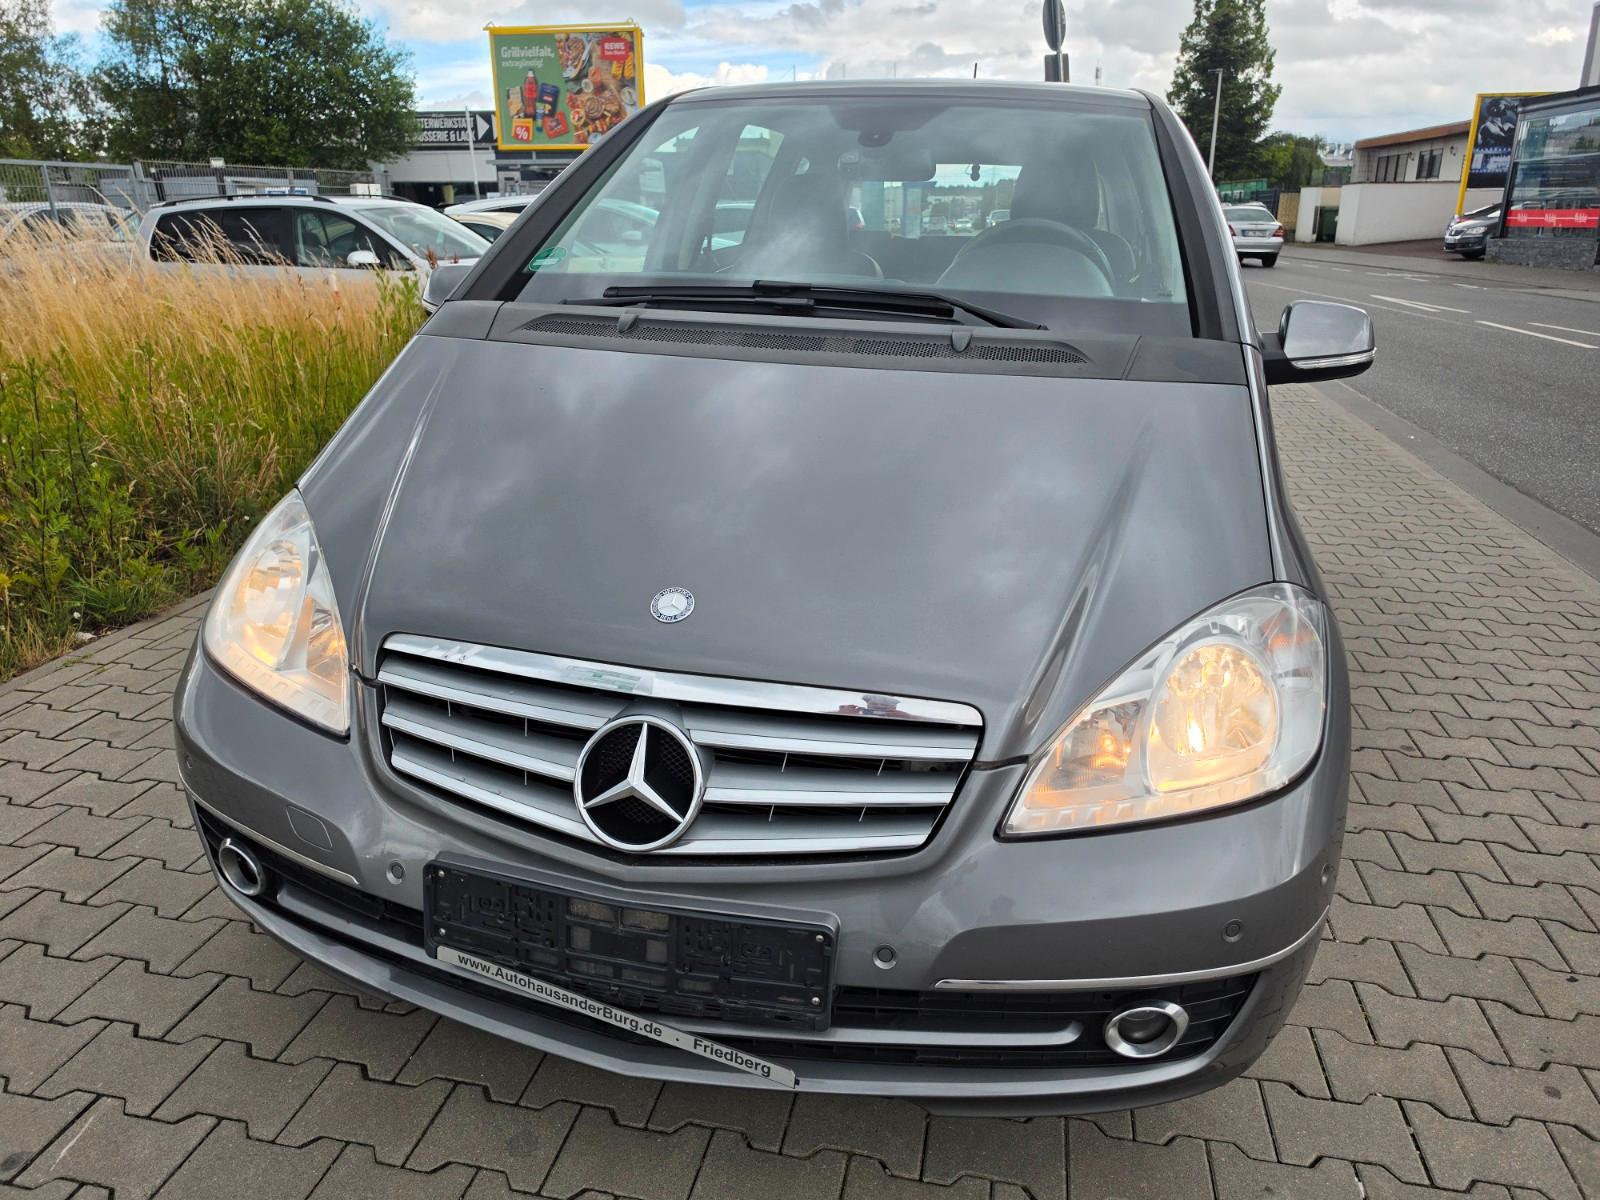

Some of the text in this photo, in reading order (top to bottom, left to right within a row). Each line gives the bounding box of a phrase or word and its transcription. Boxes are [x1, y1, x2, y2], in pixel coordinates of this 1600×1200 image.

[449, 131, 456, 141] &
[457, 953, 772, 1078] www.AutohausanderBurg.de Friedberg
